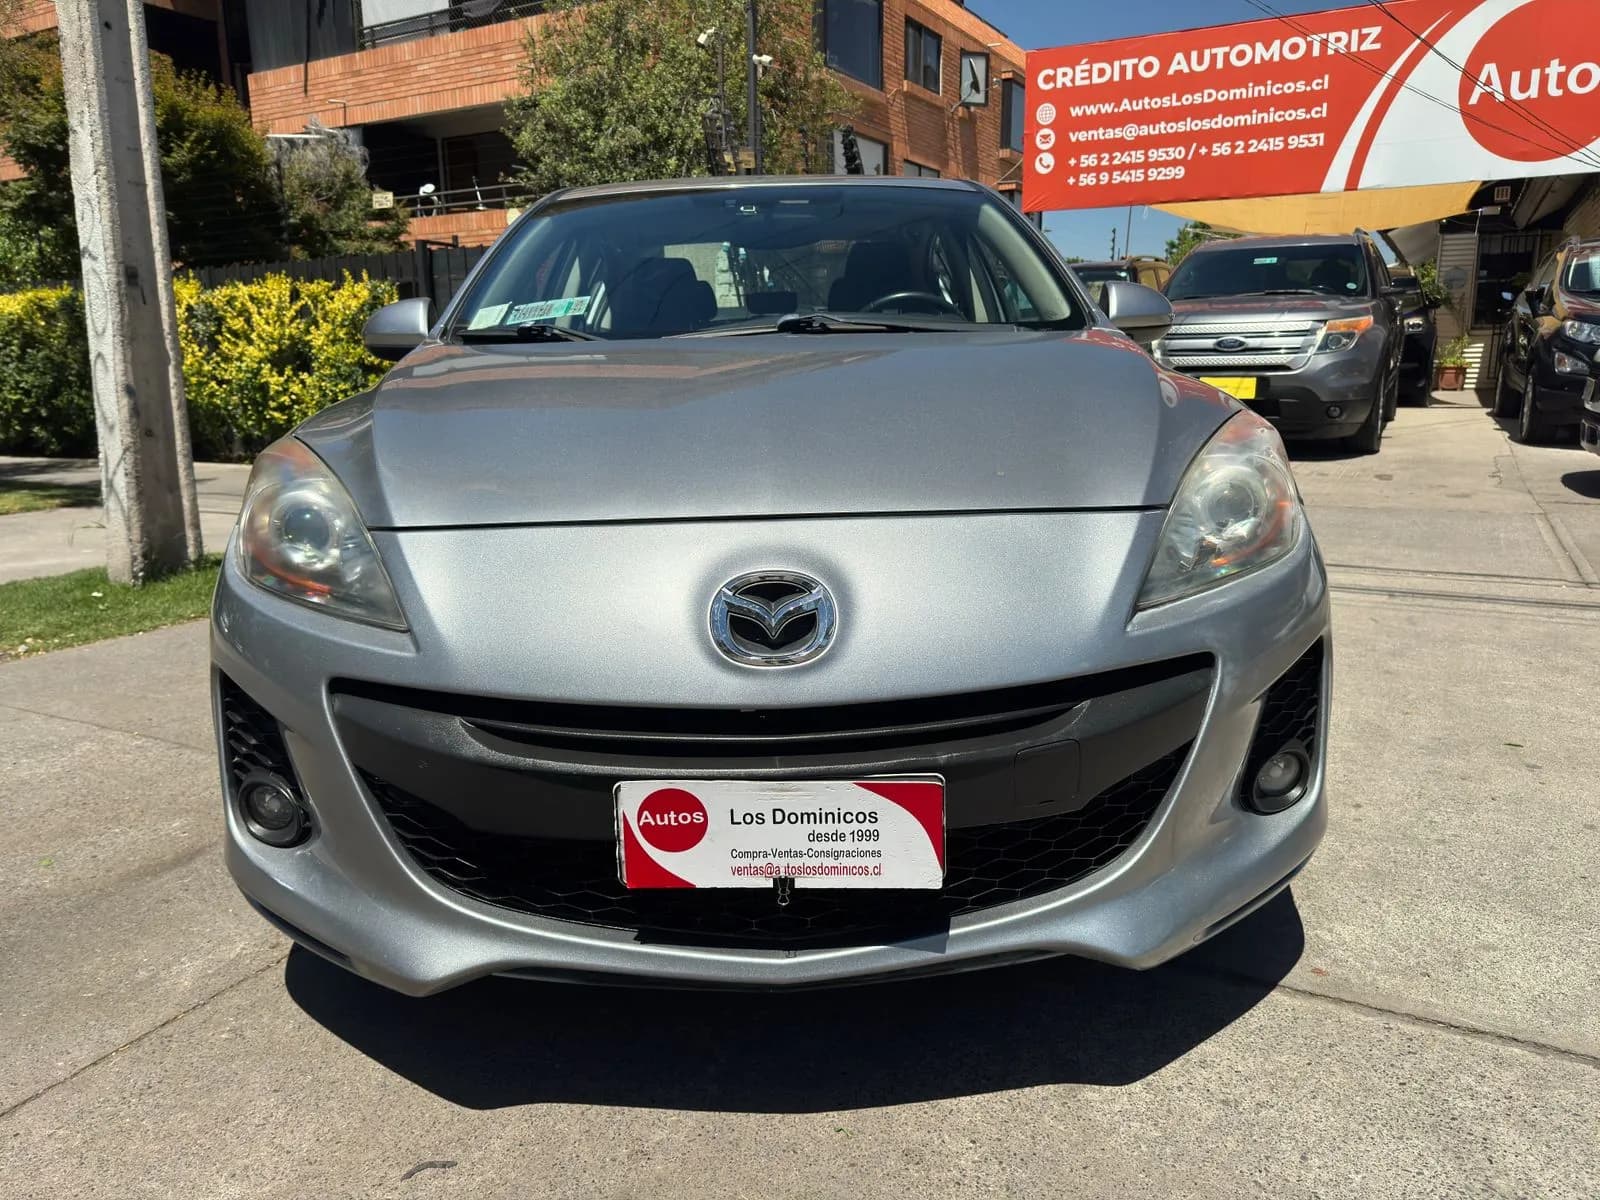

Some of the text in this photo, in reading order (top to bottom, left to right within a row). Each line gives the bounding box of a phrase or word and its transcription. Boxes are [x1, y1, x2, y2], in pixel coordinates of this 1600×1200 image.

[1037, 26, 1383, 91] CRÉDITO AUTOMOTRIZ
[1069, 74, 1329, 117] www.AutosLosDominicos.cl
[1069, 102, 1327, 142] ventas@autoslosdominicos.cl
[1068, 133, 1325, 168] + 56 2 2415 9530 / + 56 2 2415 9531
[1067, 166, 1186, 187] + 56 9 5415 9299
[639, 810, 705, 826] Autos
[730, 807, 879, 825] Los Dominicos
[807, 829, 880, 843] desde 1999
[730, 847, 882, 860] Compra-Ventas-Consignaciones
